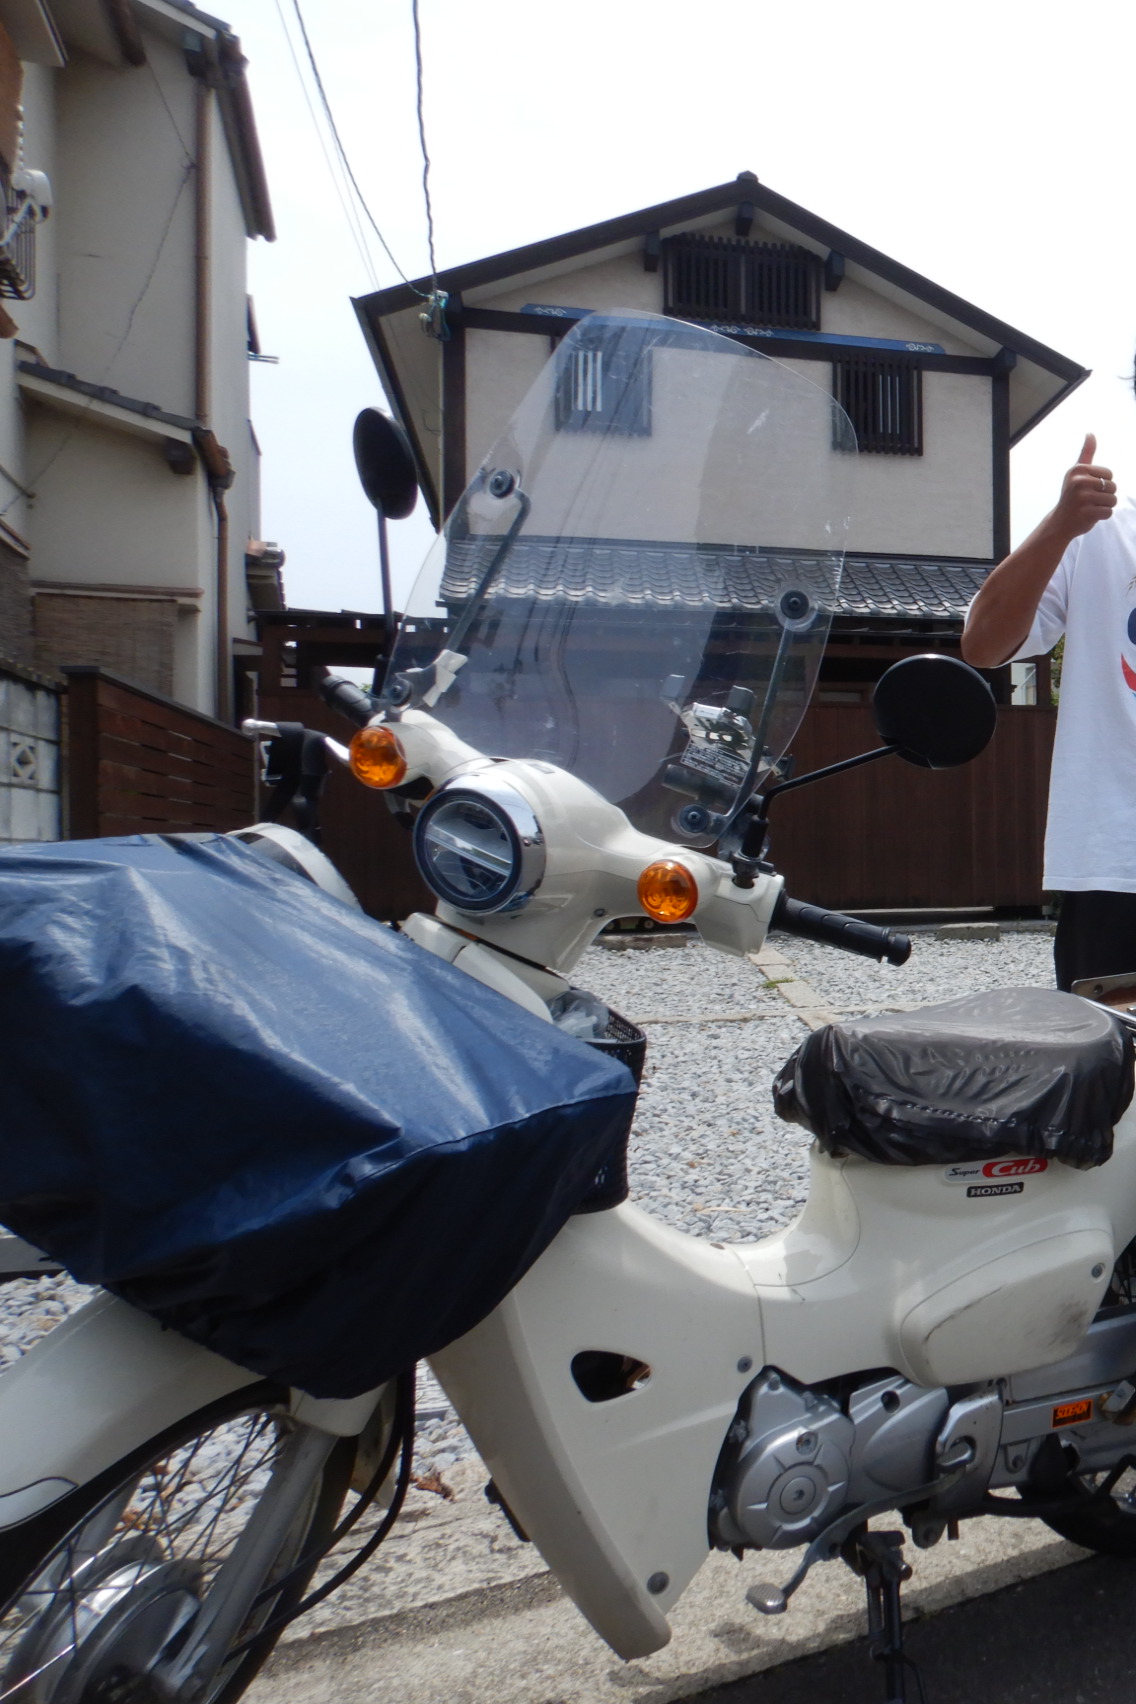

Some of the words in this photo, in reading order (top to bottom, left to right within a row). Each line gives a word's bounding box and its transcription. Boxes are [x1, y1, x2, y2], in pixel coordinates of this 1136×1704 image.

[949, 1167, 980, 1177] Super
[991, 1159, 1040, 1176] Cub
[970, 1184, 1021, 1196] HONDA
